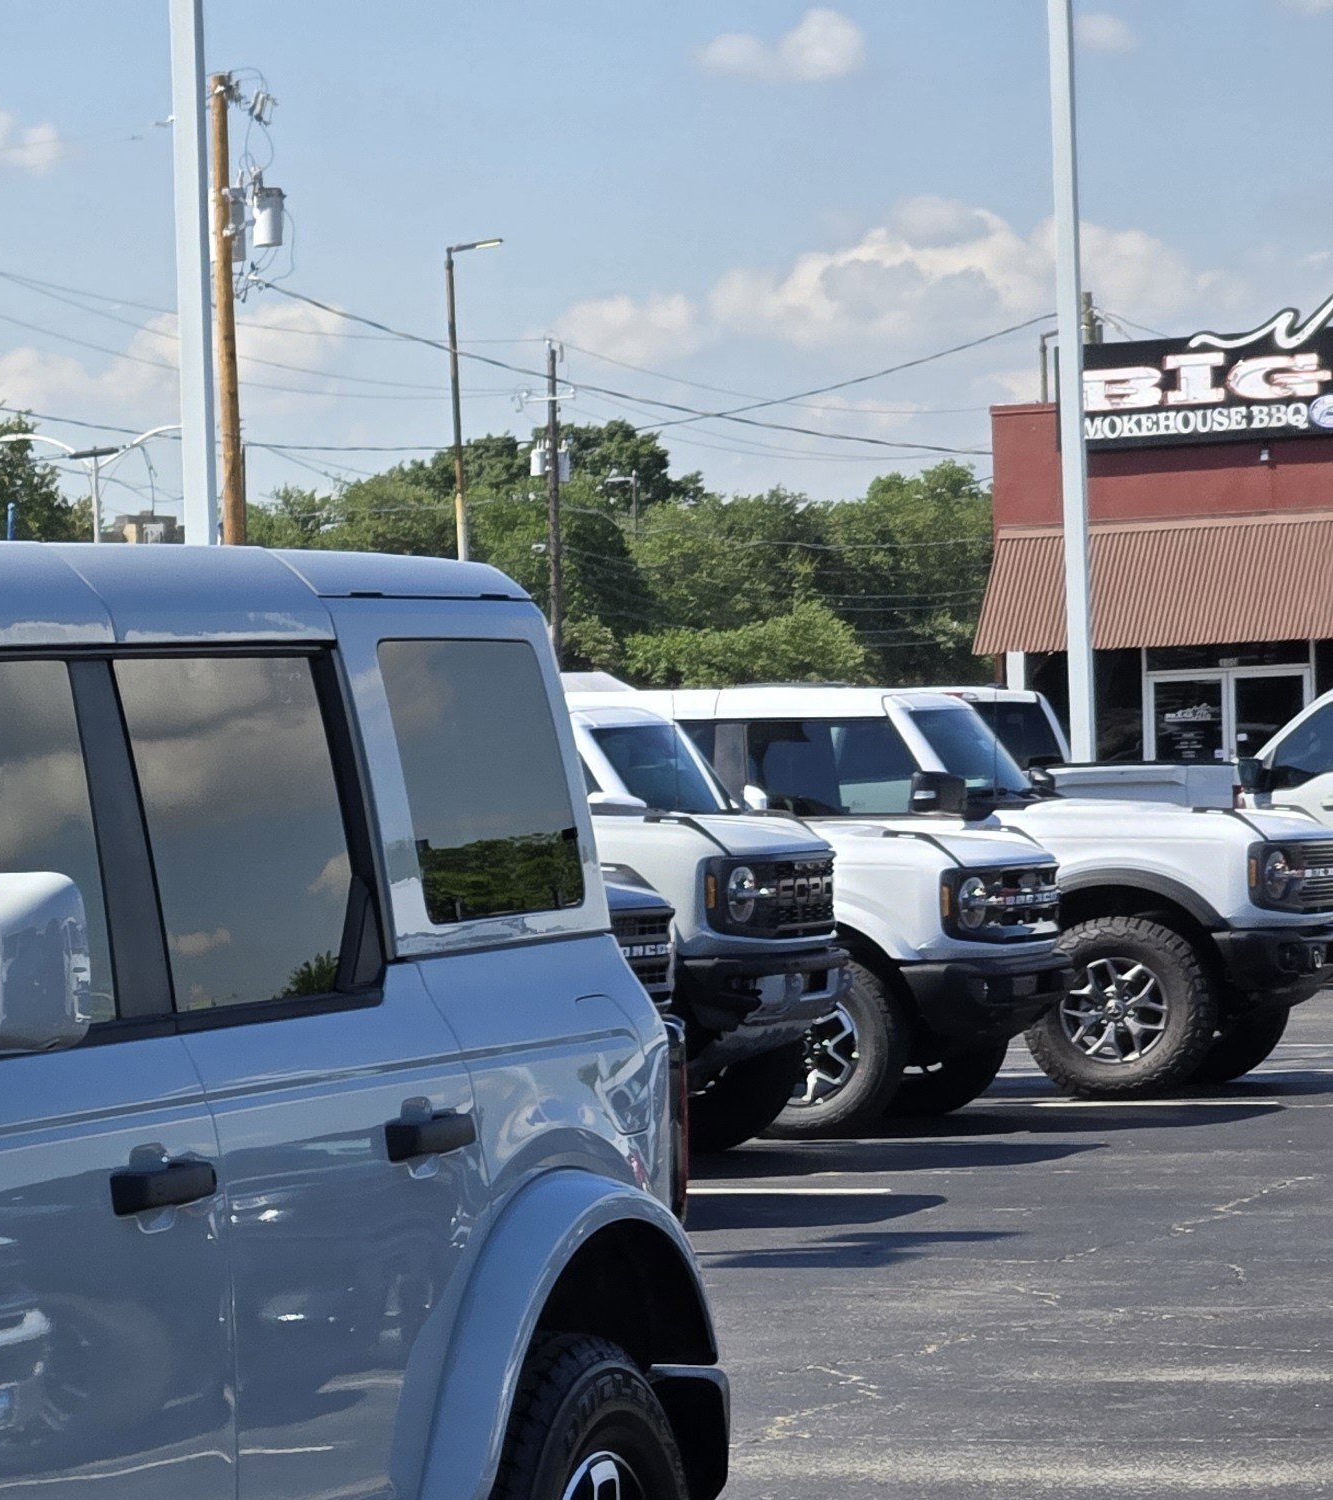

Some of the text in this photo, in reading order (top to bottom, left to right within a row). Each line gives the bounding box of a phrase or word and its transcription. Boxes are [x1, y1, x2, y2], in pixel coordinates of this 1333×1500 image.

[1083, 352, 1332, 411] BIG
[1084, 403, 1308, 439] MOKEHOUSE BBQ
